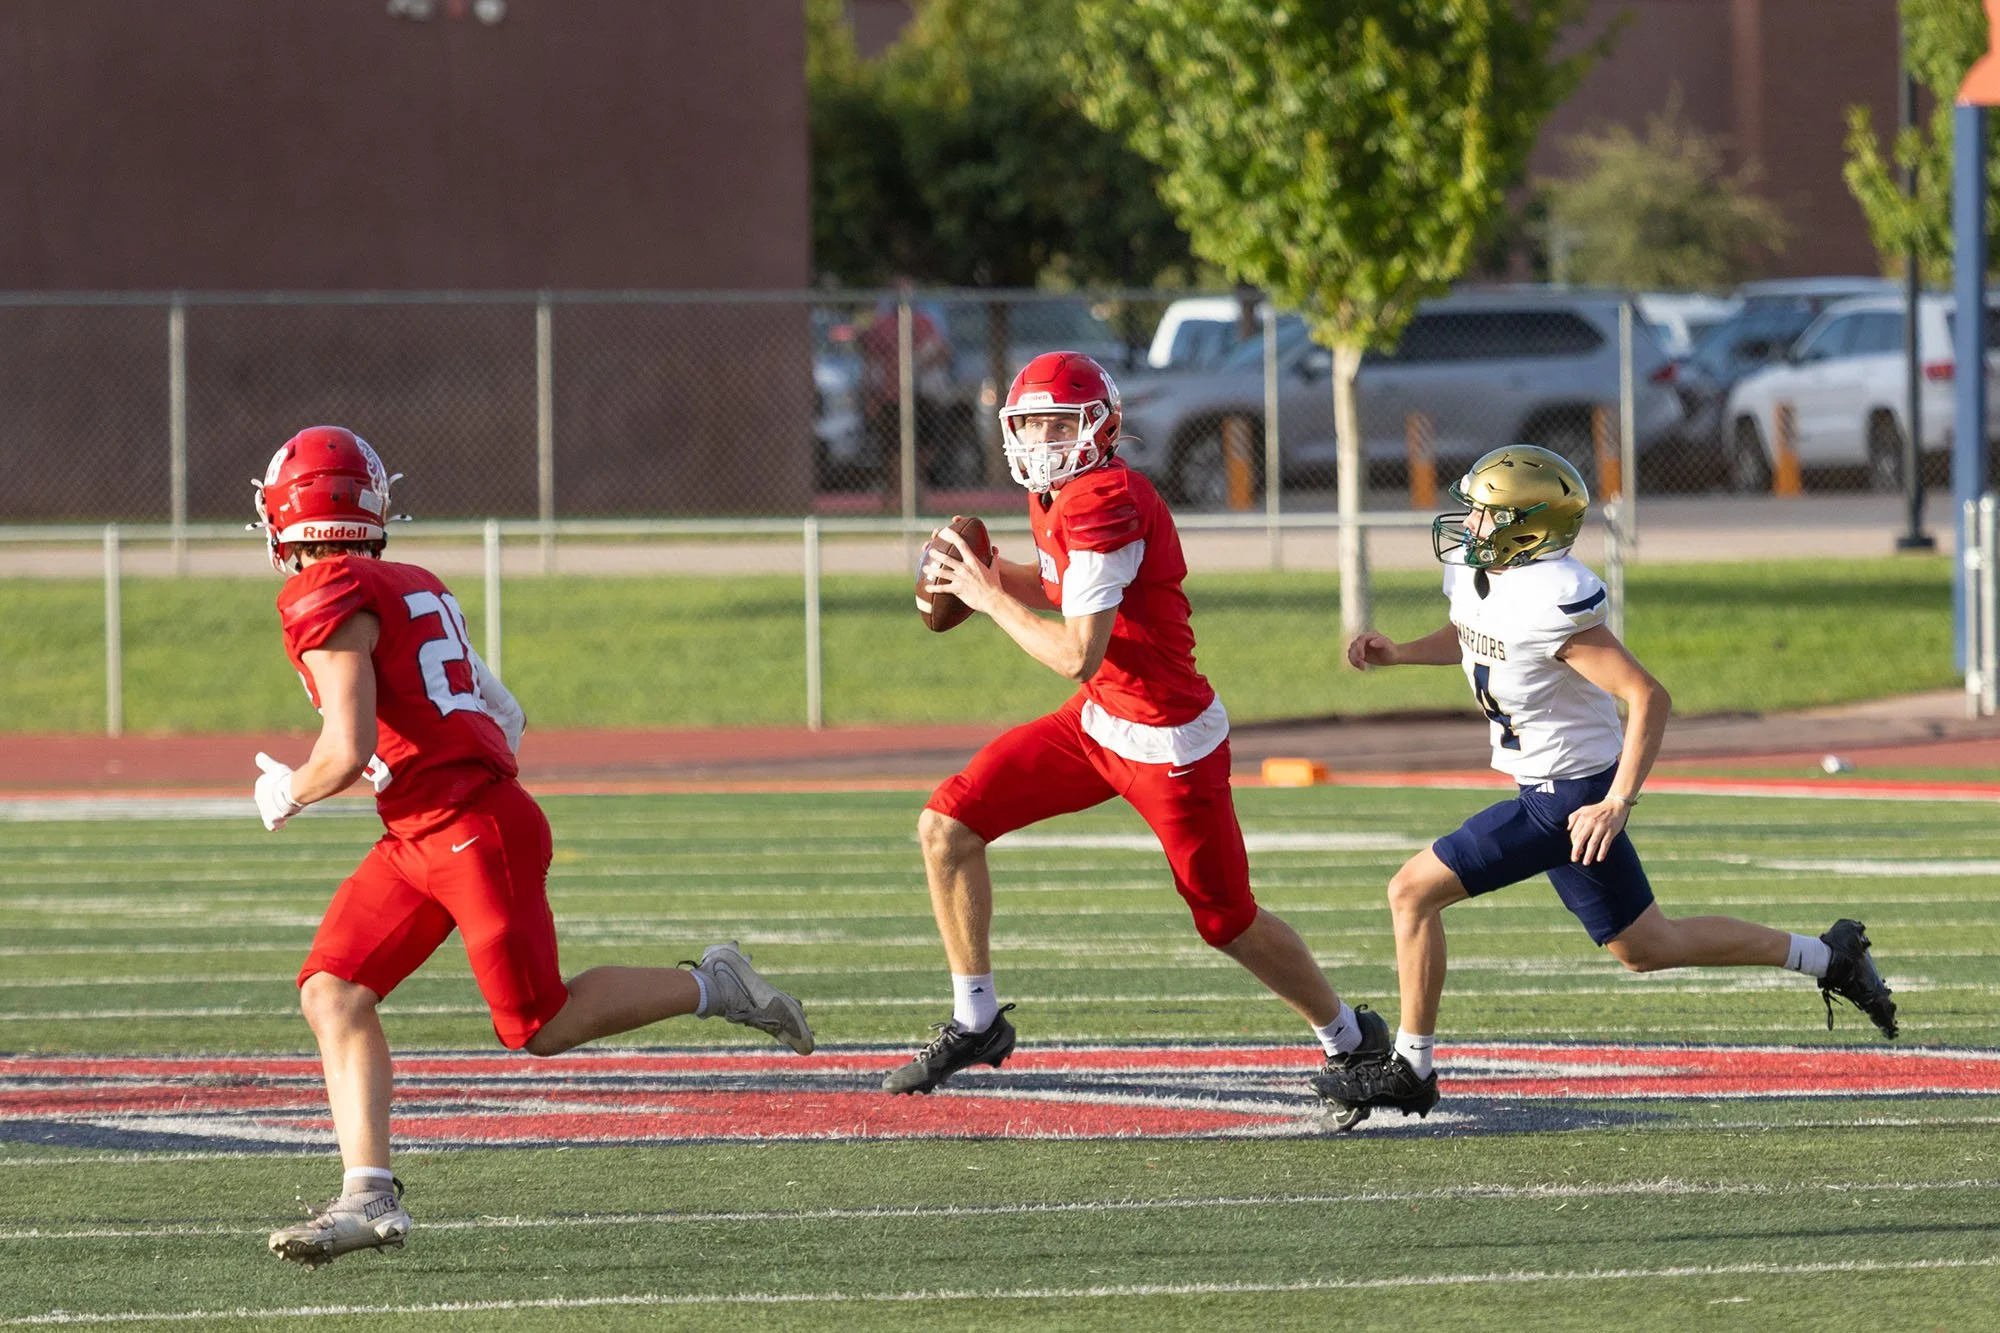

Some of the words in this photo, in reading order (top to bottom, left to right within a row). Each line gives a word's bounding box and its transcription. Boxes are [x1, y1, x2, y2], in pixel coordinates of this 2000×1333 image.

[303, 526, 368, 539] Riddell
[1473, 661, 1522, 752] 4
[364, 1195, 398, 1222] NIKE
